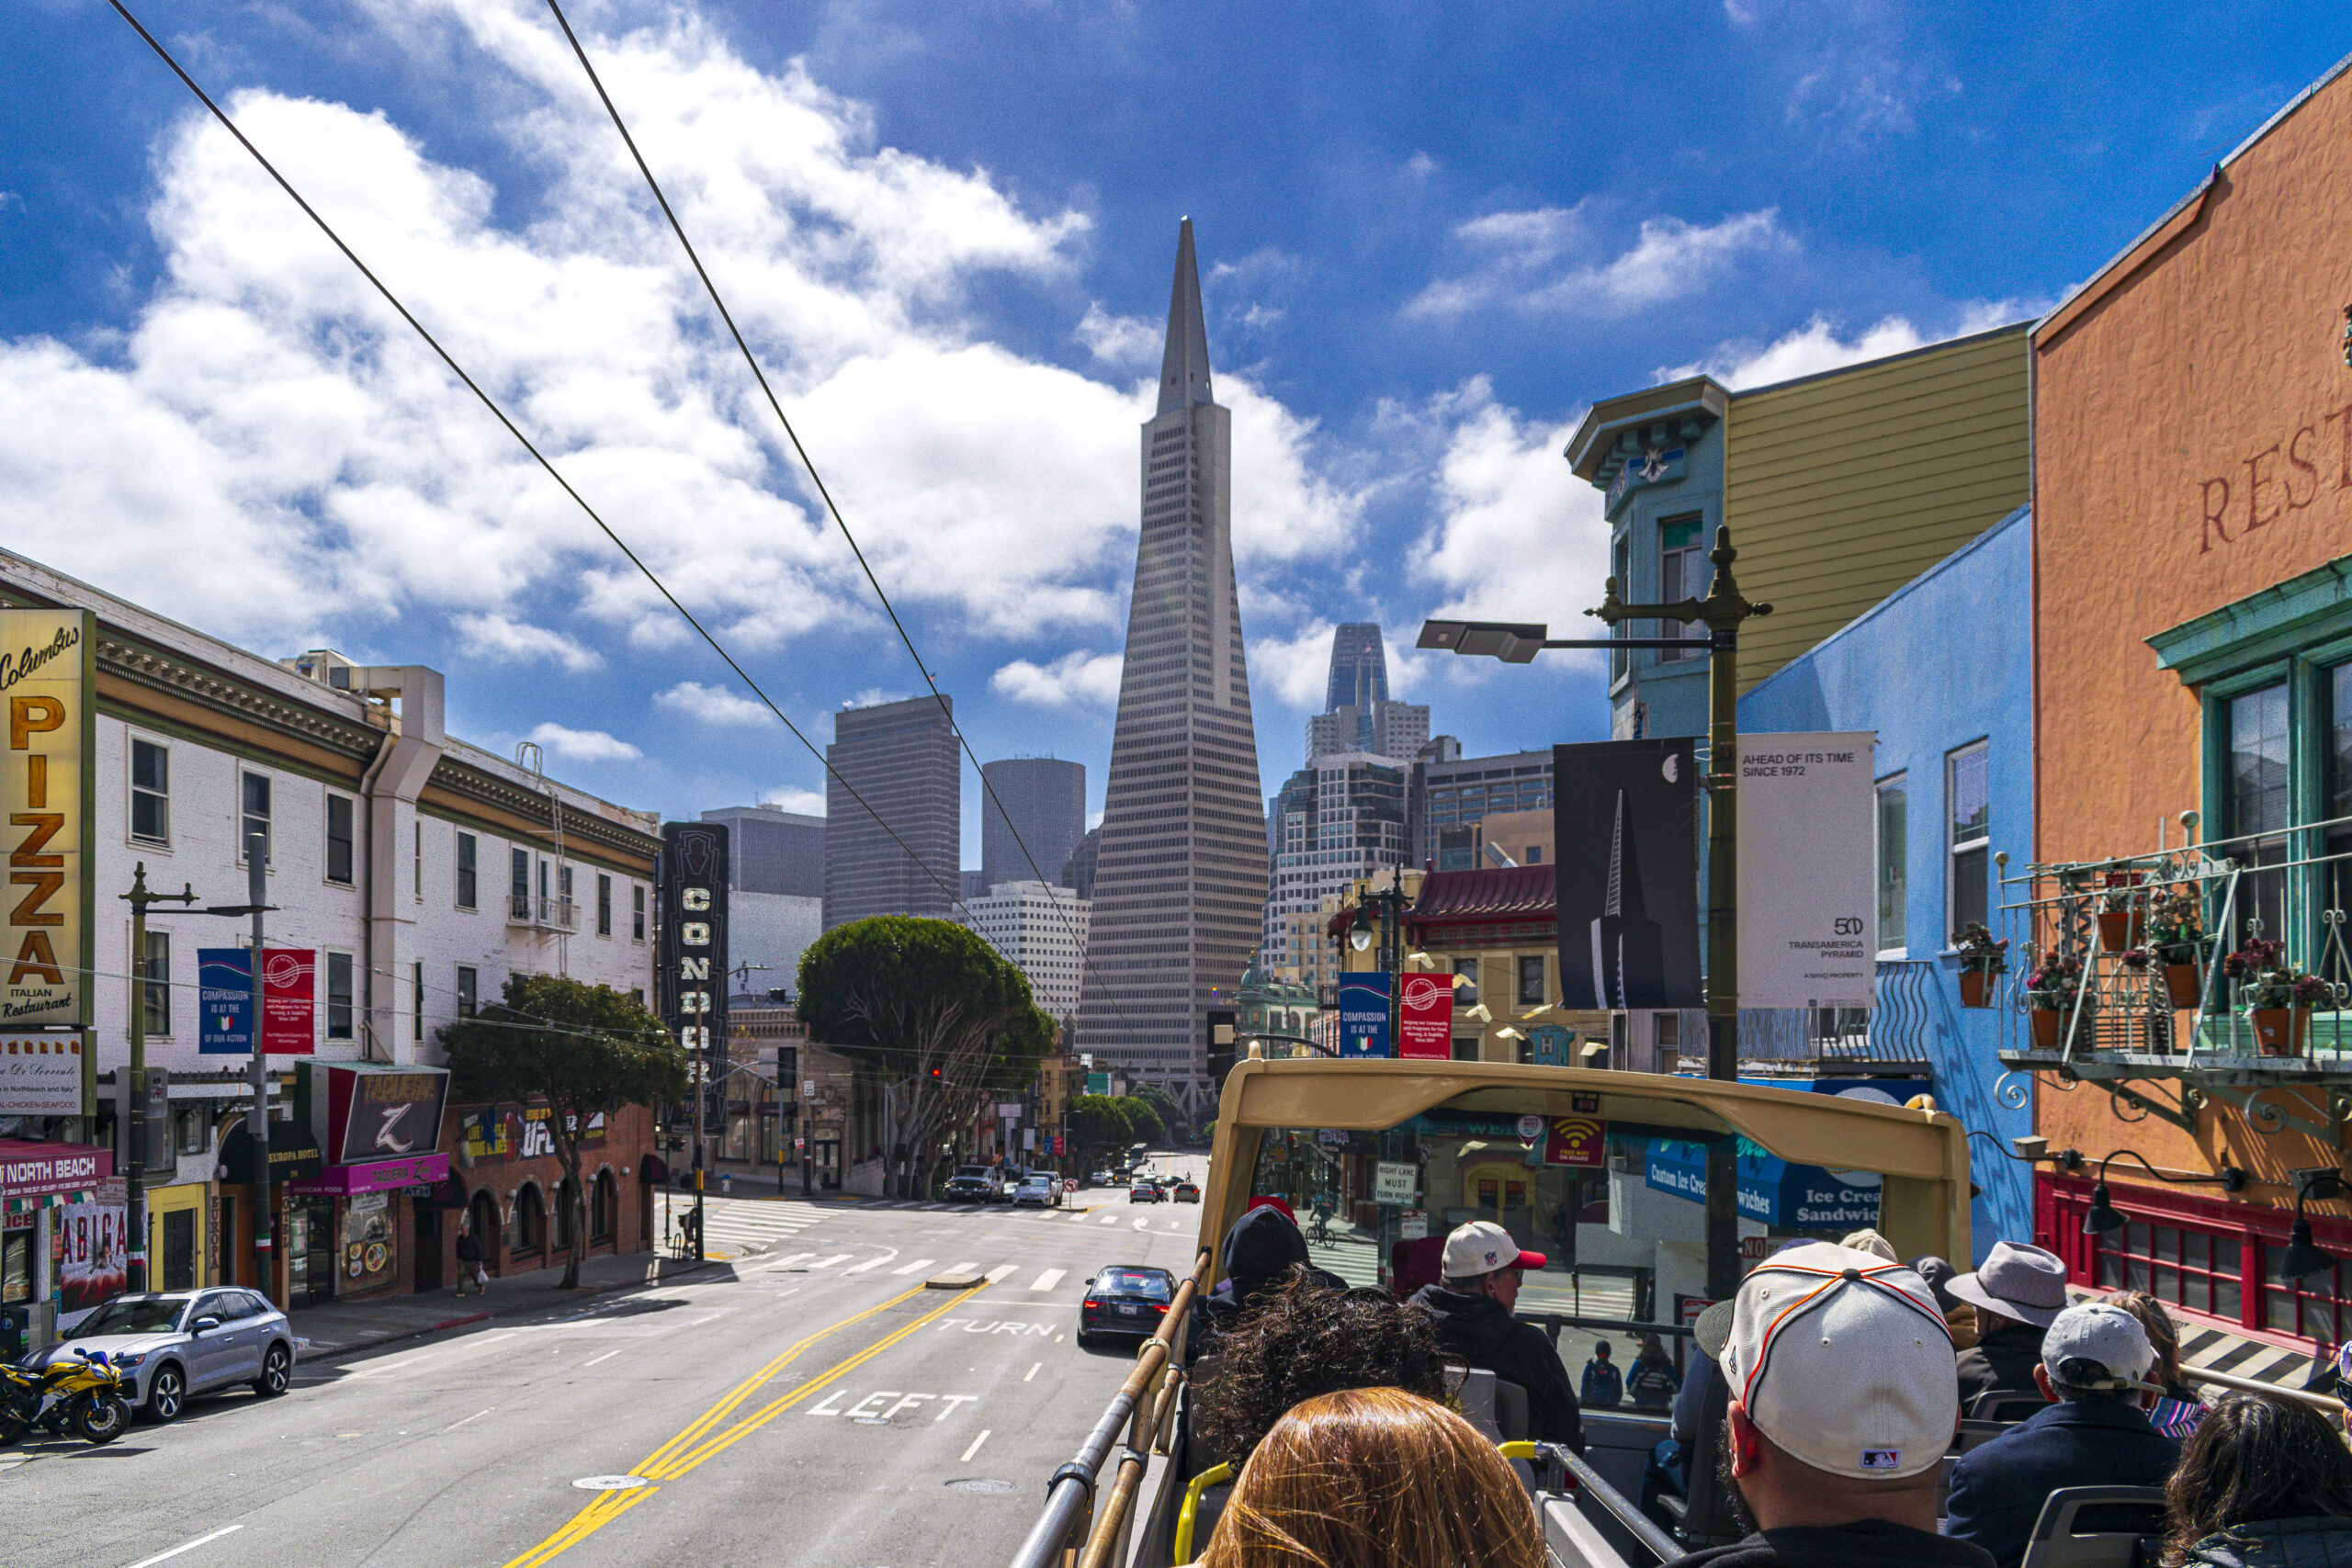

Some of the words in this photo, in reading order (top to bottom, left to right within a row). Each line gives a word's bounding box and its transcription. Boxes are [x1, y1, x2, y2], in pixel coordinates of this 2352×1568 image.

[2198, 402, 2352, 555] REST
[0, 626, 80, 690] Columbus
[1742, 754, 1784, 765] AHEAD
[1786, 753, 1804, 764] OF
[1805, 752, 1824, 763] ITS
[1826, 752, 1855, 763] TIME
[1742, 766, 1779, 777] SINCE
[1781, 765, 1806, 776] 1972
[7, 695, 66, 986] PIZZA
[1834, 917, 1864, 936] 50
[1788, 940, 1864, 950] TRANSAMERICA
[1821, 950, 1864, 958] PYRAMID
[10, 988, 52, 998] ITALIAN
[680, 887, 711, 1084] CONDOR
[202, 990, 249, 1001] COMPASSION
[2, 992, 72, 1019] Restaurant
[210, 1004, 218, 1014] IS
[218, 1004, 227, 1013] AT
[229, 1004, 240, 1013] THE
[1342, 1011, 1386, 1022] COMPASSION
[1351, 1024, 1357, 1034] IS
[1358, 1024, 1366, 1034] AT
[1367, 1024, 1378, 1034] THE
[205, 1034, 212, 1043] OF
[213, 1034, 225, 1043] OUR
[226, 1033, 247, 1043] ACTION
[1541, 1035, 1553, 1057] H
[268, 1150, 297, 1164] EUROPA
[297, 1148, 320, 1160] HOTEL
[7, 1161, 52, 1183] NORTH
[55, 1156, 96, 1179] BEACH
[372, 1167, 410, 1184] TAQUERIA
[1379, 1166, 1397, 1175] RIGHT
[1398, 1168, 1414, 1177] LANE
[1385, 1179, 1407, 1188] MUST
[1651, 1163, 1677, 1188] Custom
[1677, 1169, 1689, 1190] Ice
[1690, 1174, 1706, 1195] Crea
[1736, 1188, 1770, 1214] wiches
[1376, 1190, 1393, 1199] TURN
[1394, 1191, 1413, 1200] RIGHT
[1806, 1190, 1835, 1202] Ice
[1839, 1189, 1882, 1203] Crea
[3, 1213, 32, 1229] ICE
[1796, 1207, 1879, 1222] Sandwic
[62, 1211, 128, 1265] ABIGA
[209, 1195, 220, 1271] EUROPA
[1745, 1238, 1764, 1258] NO
[936, 1318, 1057, 1337] TURN
[805, 1389, 980, 1421] LEFT
